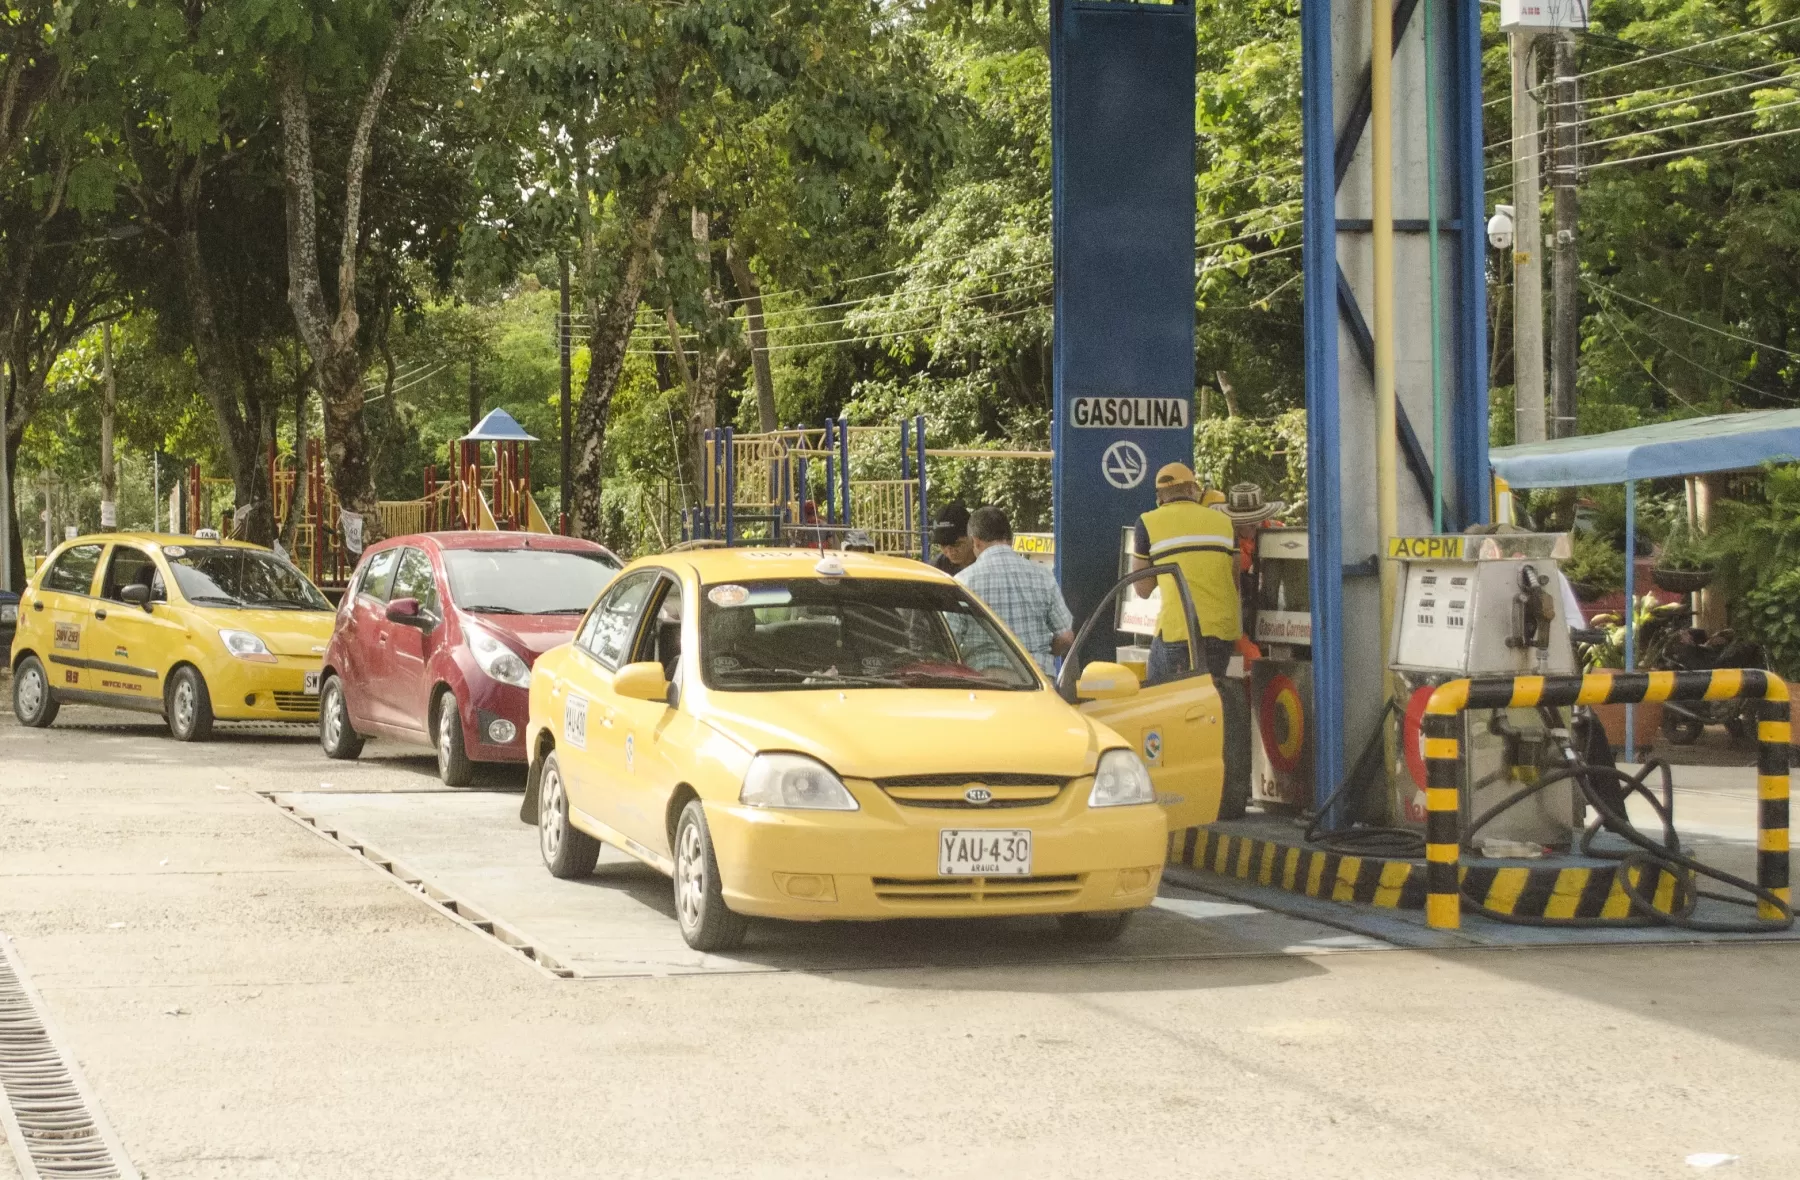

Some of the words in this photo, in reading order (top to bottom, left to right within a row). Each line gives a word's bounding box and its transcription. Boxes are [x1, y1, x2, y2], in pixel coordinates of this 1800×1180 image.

[1521, 7, 1540, 15] ABB
[1074, 398, 1183, 427] GASOLINA
[1017, 538, 1053, 552] ACPM
[1394, 538, 1458, 557] ACPM
[306, 675, 320, 688] SW
[969, 790, 988, 800] KIA
[971, 864, 1000, 872] ARAUCA
